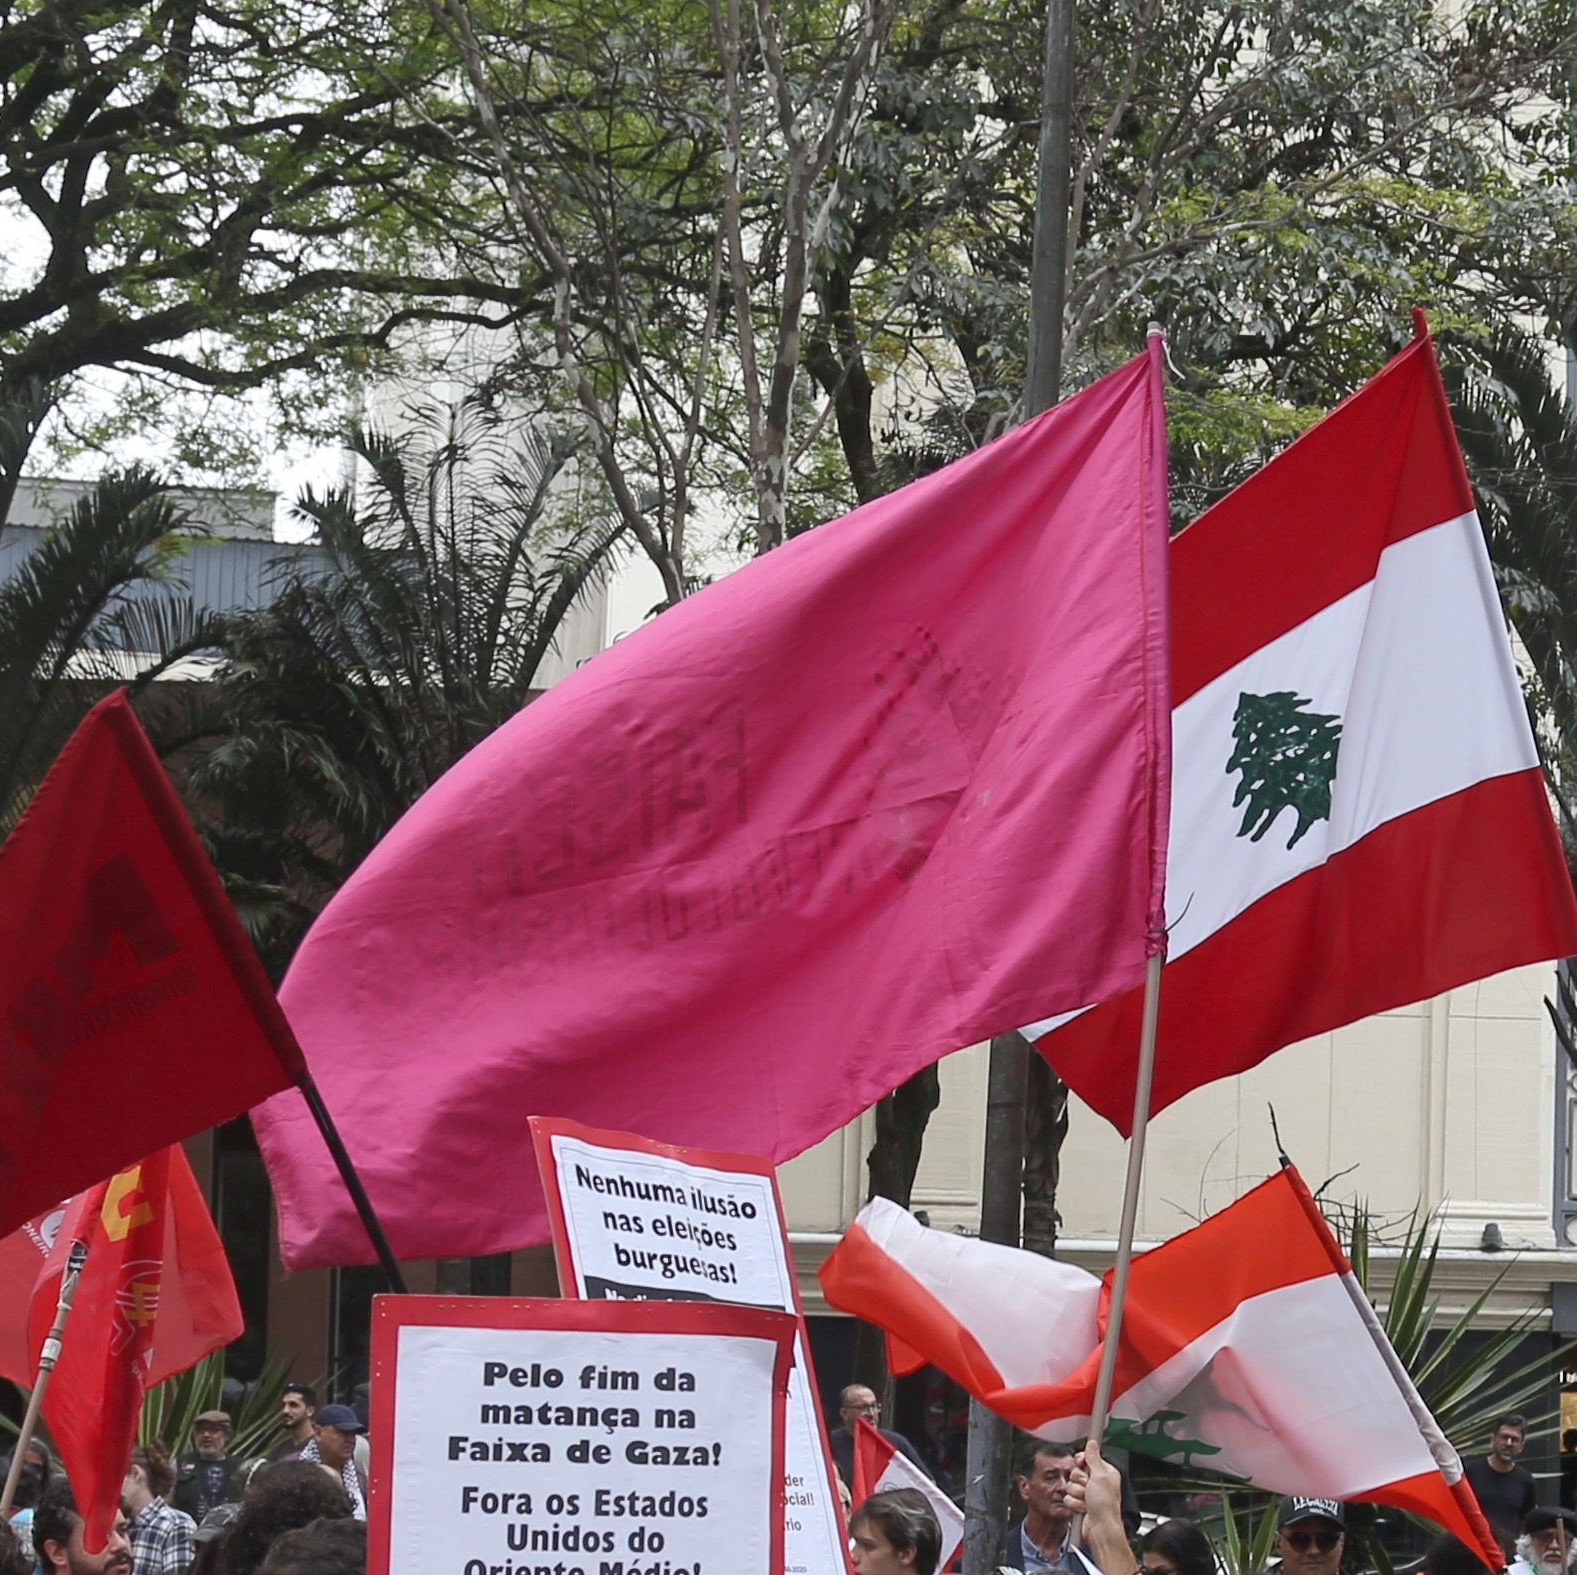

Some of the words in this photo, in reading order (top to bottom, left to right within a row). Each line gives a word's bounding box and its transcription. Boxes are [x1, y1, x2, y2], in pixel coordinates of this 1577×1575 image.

[575, 1164, 687, 1205] Nenhuma
[691, 1187, 756, 1219] ilusão
[602, 1211, 643, 1233] nas
[652, 1215, 737, 1251] eleições
[615, 1243, 737, 1284] burguesas!
[483, 1362, 563, 1388] Pelo
[579, 1365, 639, 1390] fim
[654, 1367, 696, 1392] da
[480, 1402, 639, 1434] matança
[654, 1409, 696, 1429] na
[448, 1436, 551, 1463] Faixa
[567, 1440, 611, 1464] de
[625, 1440, 722, 1466] Gaza!
[461, 1486, 532, 1515] Fora
[546, 1494, 580, 1515] os
[595, 1490, 708, 1517] Estados
[507, 1523, 615, 1552] Unidos
[628, 1526, 665, 1552] do
